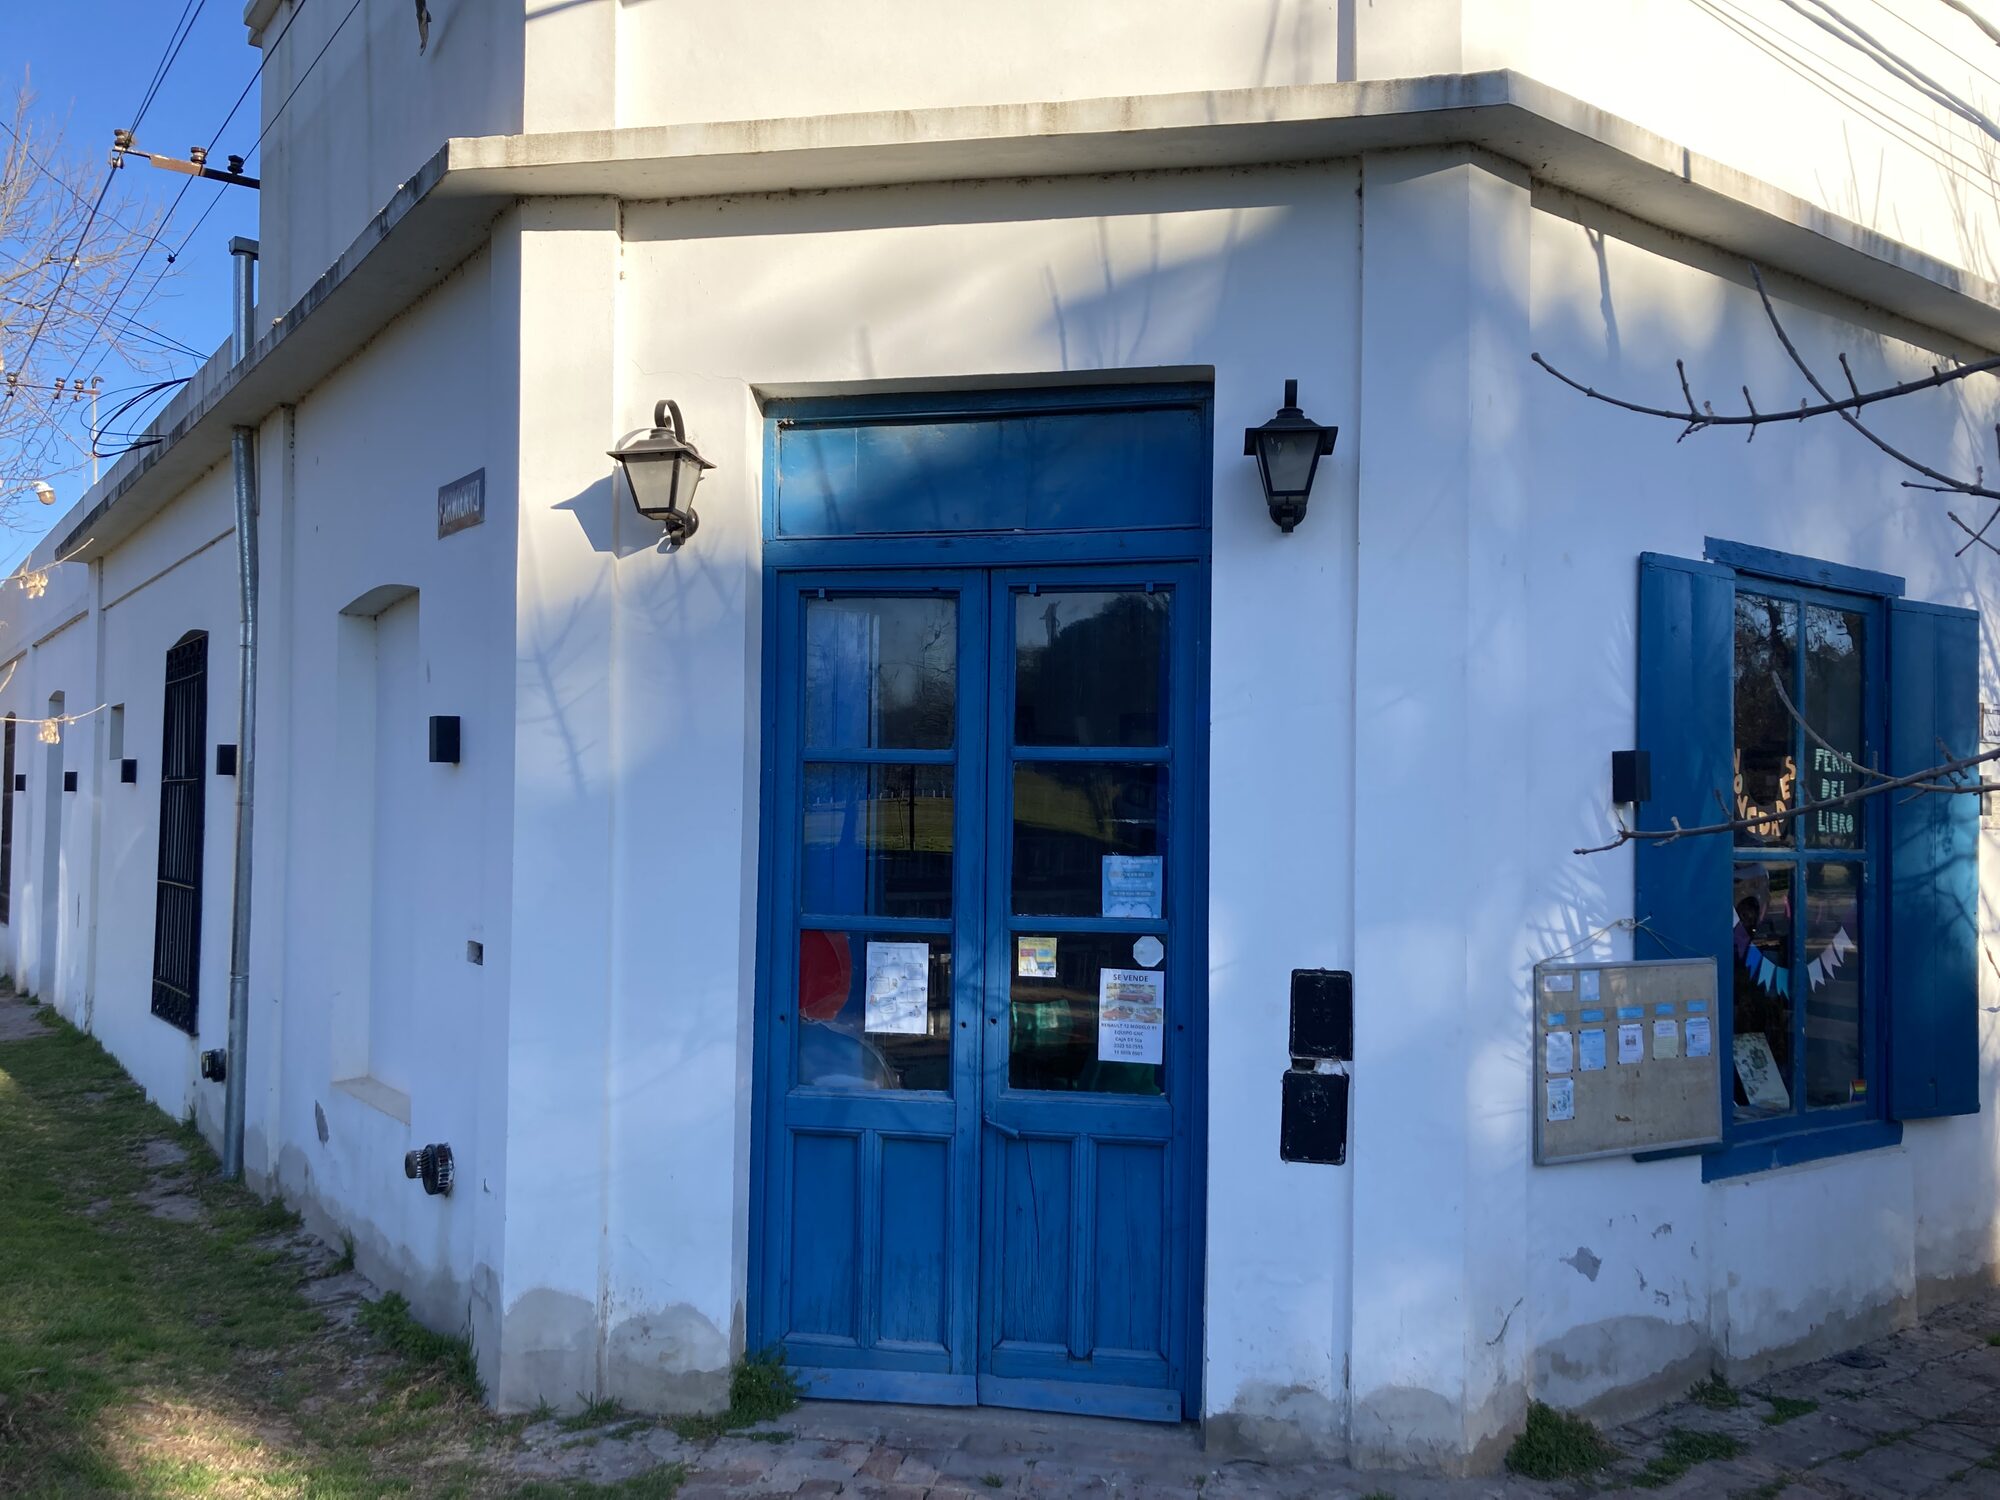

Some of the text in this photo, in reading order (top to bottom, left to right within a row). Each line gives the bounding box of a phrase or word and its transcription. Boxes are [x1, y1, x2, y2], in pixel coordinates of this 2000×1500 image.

[1814, 748, 1853, 773] FERIA
[1821, 778, 1846, 800] DEL
[1818, 810, 1853, 834] LIBRO
[1123, 974, 1149, 982] VENDE
